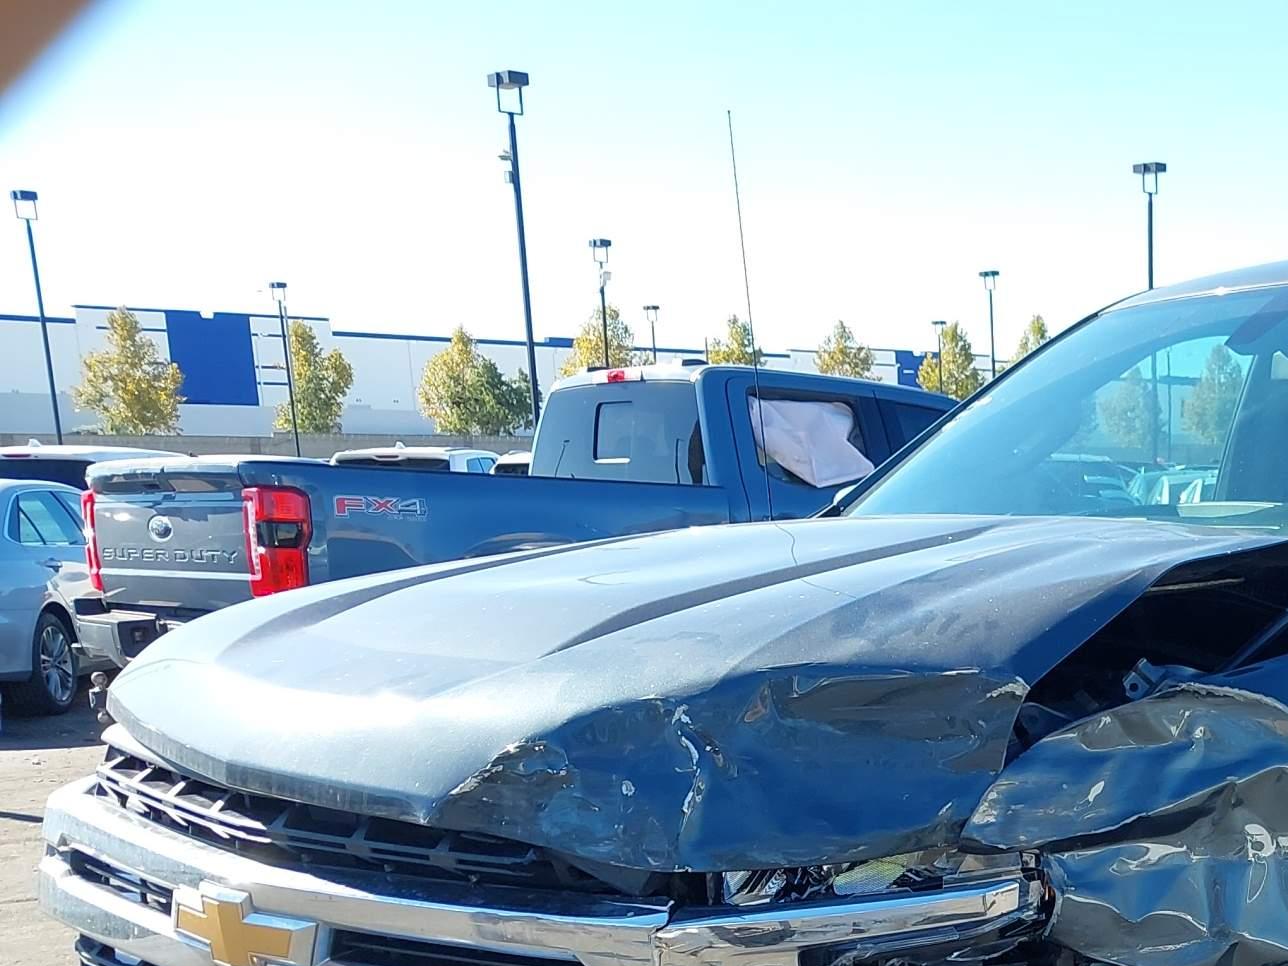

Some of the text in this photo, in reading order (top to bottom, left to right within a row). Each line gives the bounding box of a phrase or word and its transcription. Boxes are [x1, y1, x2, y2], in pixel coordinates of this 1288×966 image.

[334, 495, 427, 519] FX4
[103, 548, 238, 564] SUPER DUTY
